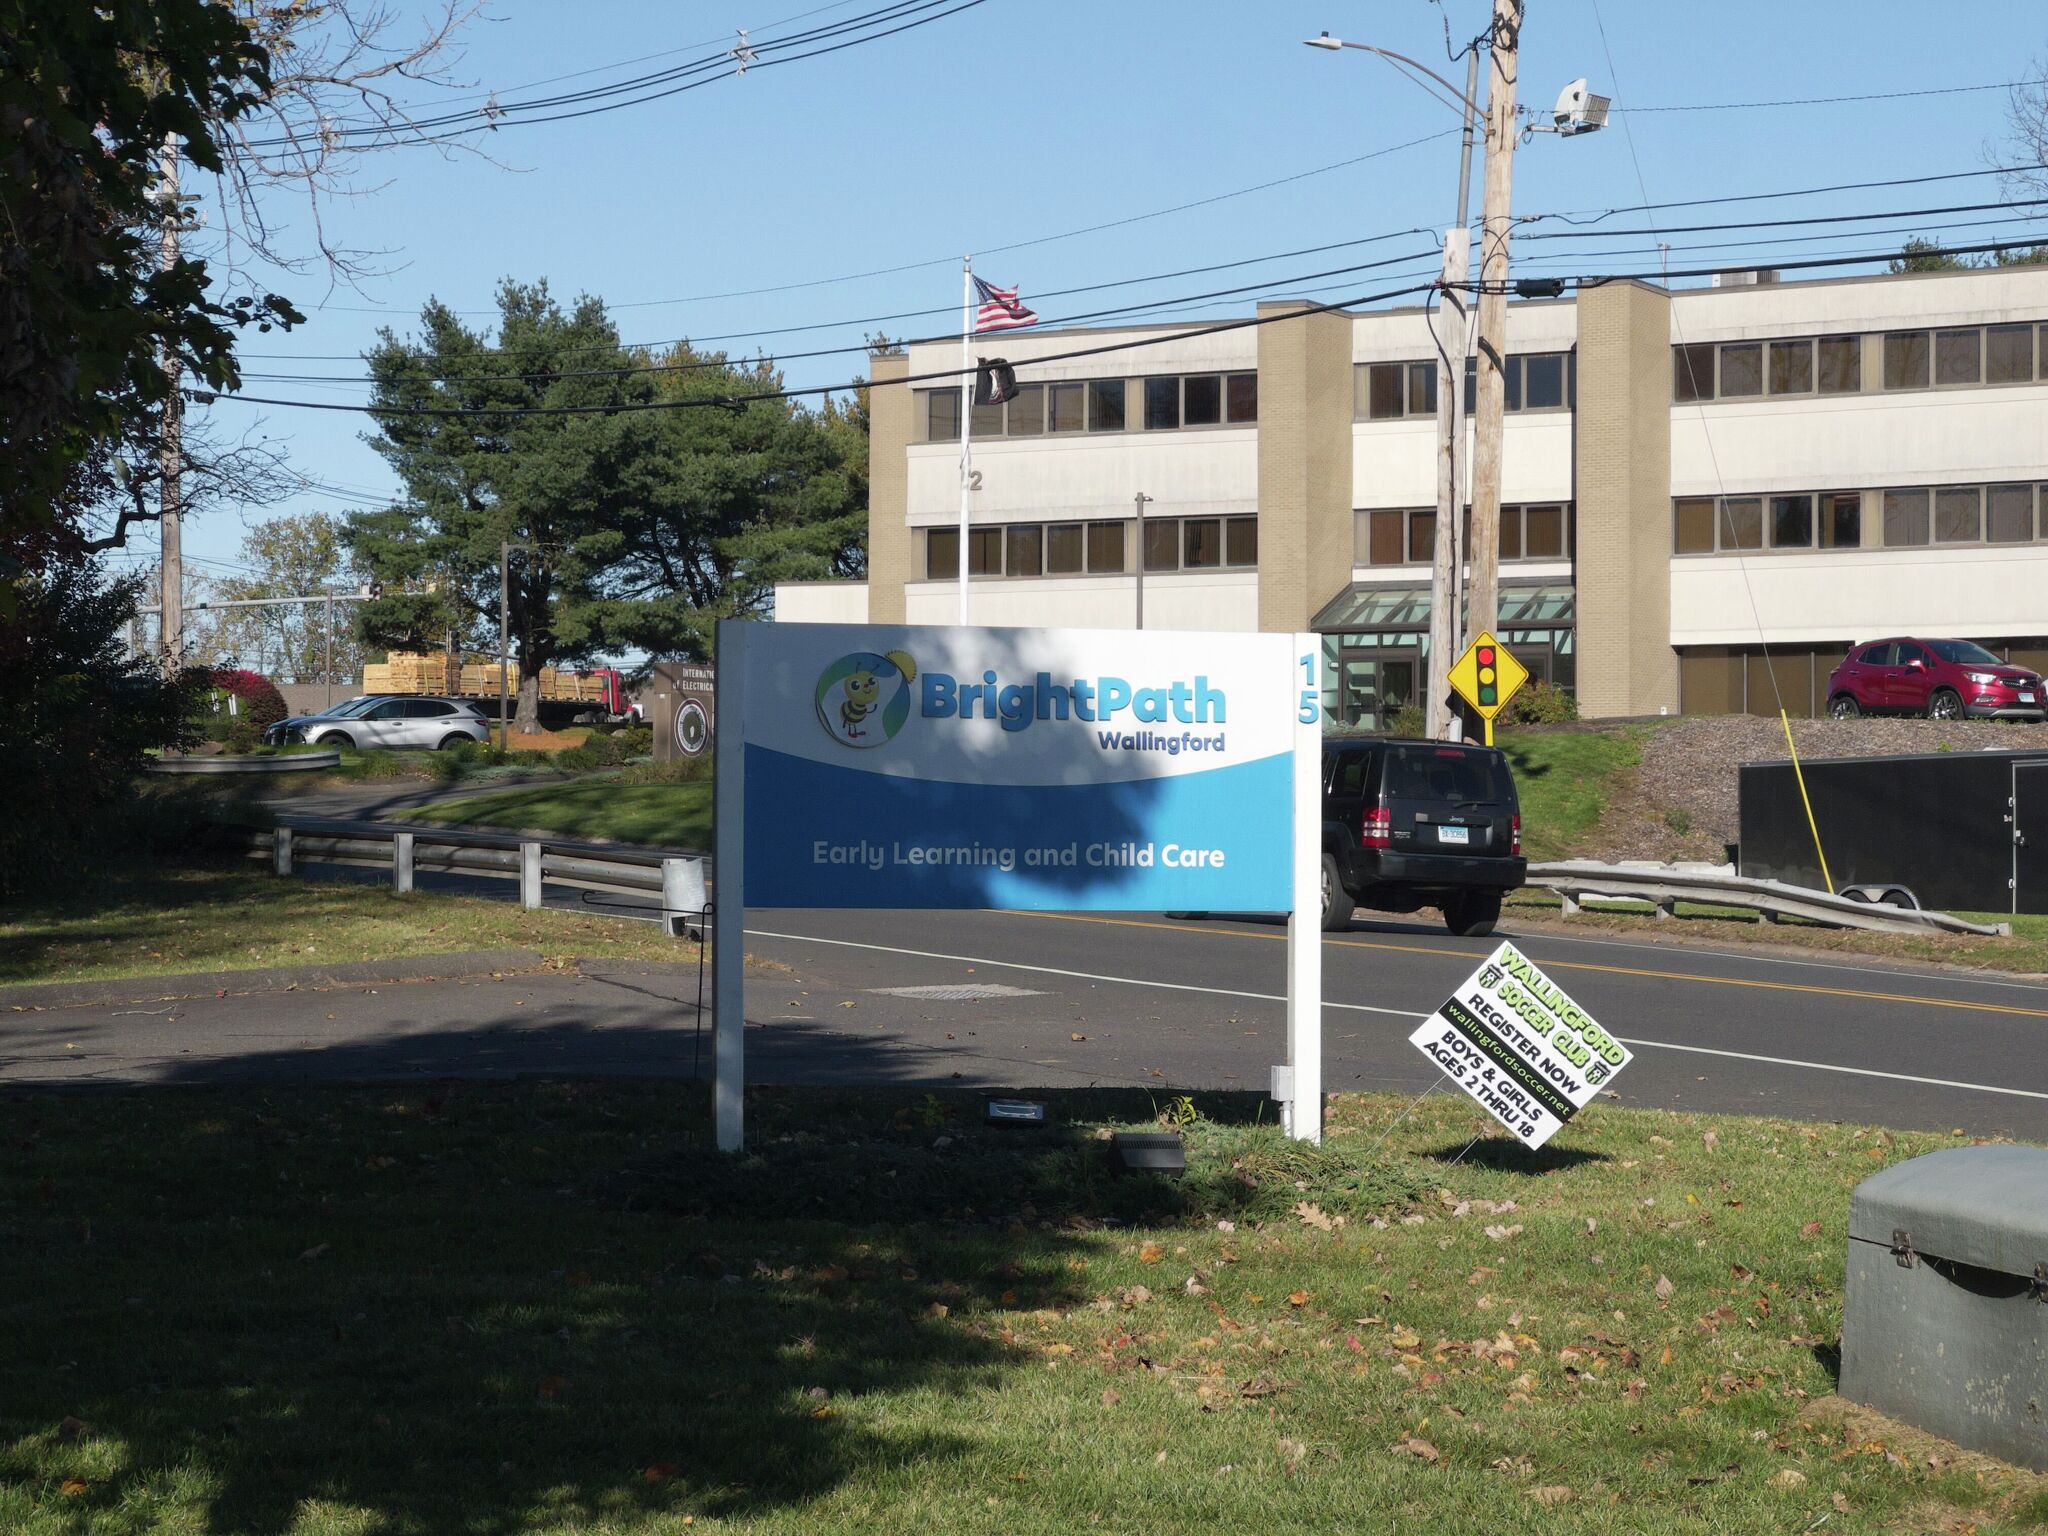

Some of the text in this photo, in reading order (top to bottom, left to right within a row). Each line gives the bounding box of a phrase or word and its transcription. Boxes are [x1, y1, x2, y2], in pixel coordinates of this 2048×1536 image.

[970, 470, 983, 491] 2
[921, 669, 1227, 732] BrightPath
[1097, 731, 1226, 755] Wallingford
[813, 839, 1226, 872] Early Learning and Child Care
[1467, 993, 1582, 1095] REGISTER NOW
[1497, 981, 1592, 1068] SOCCER CLUB
[1499, 946, 1625, 1067] WALLINGFORD
[1423, 1040, 1536, 1139] AGES 2 THRU 18
[1441, 1029, 1543, 1122] BOYS & GIRLS
[1447, 1004, 1572, 1117] wallingfordsoccer.net
